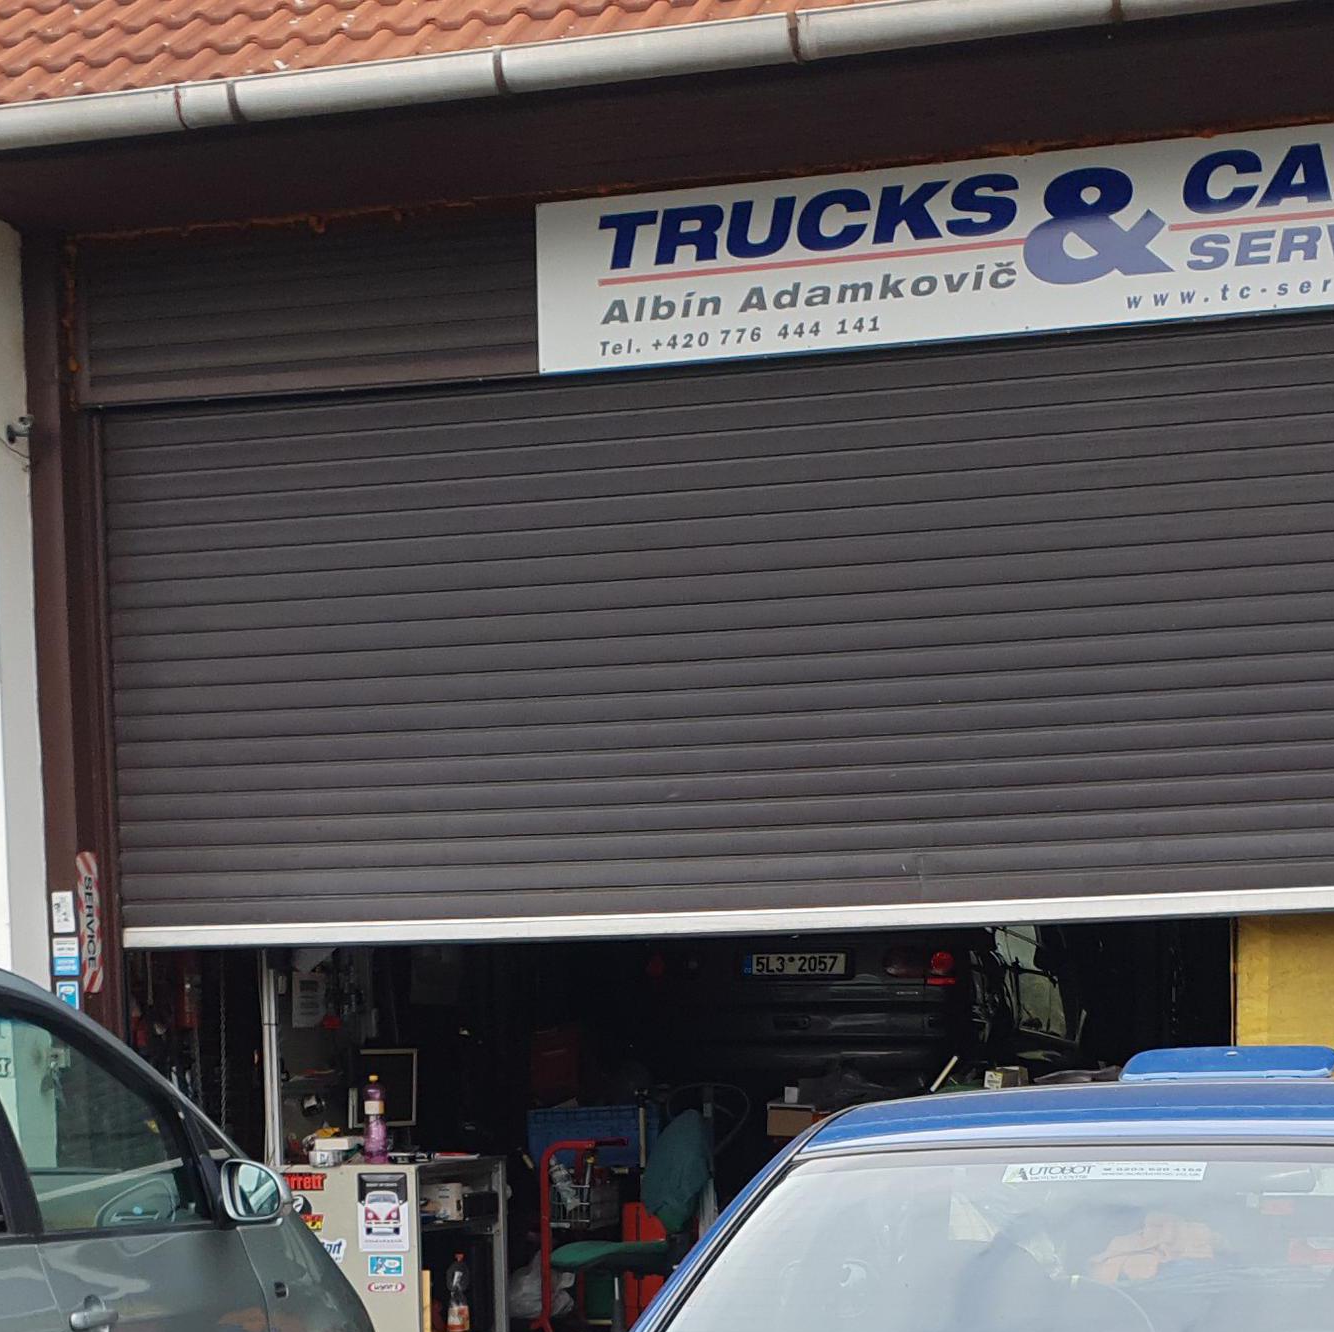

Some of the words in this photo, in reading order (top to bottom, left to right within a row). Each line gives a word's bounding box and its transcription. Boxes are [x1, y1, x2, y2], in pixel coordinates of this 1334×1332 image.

[599, 173, 1020, 270] TRUCKS
[1023, 166, 1175, 284] &
[600, 291, 722, 325] Albín
[738, 261, 1017, 314] Adamkovič
[599, 338, 642, 357] Tel.
[651, 331, 710, 352] +420
[720, 326, 762, 346] 776
[777, 320, 821, 341] 444
[836, 316, 880, 336] 141
[83, 876, 98, 969] SERVICE
[755, 956, 785, 973] 5L3
[797, 955, 838, 973] 2057
